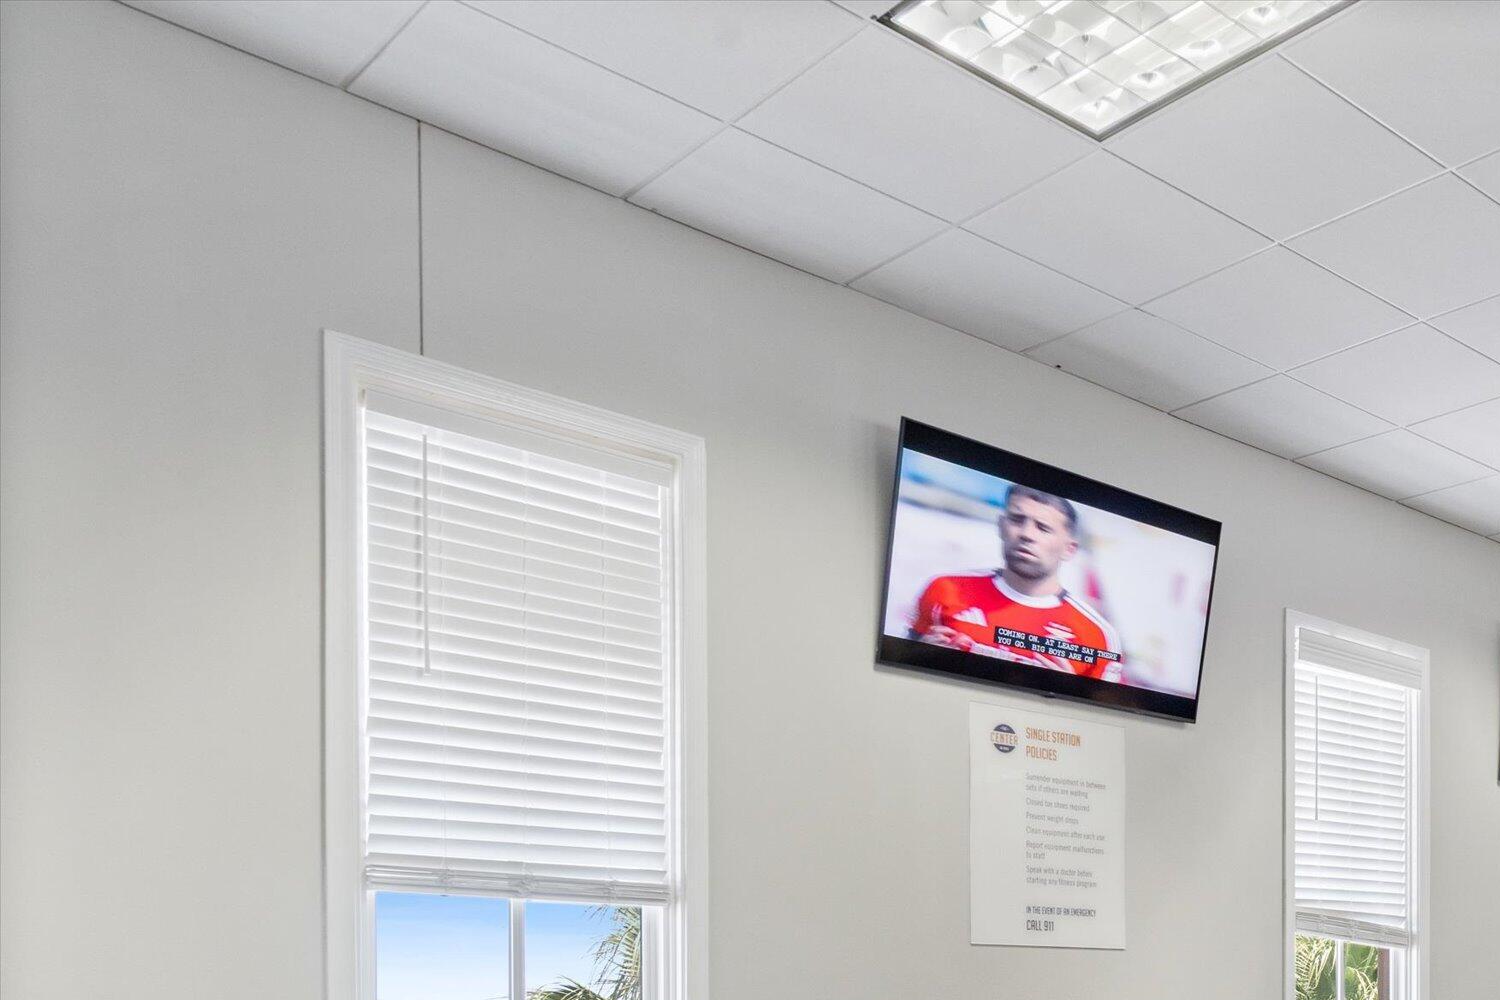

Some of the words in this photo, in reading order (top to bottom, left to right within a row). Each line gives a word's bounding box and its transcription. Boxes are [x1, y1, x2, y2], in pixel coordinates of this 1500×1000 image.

[998, 627, 1025, 639] COMING
[1028, 634, 1040, 643] ON.
[1045, 638, 1054, 647] AT
[1057, 640, 1080, 652] LEAST
[1081, 648, 1095, 656] SAY
[1097, 650, 1118, 661] THERE
[998, 636, 1012, 645] YOU
[1014, 640, 1027, 649] GO.
[1031, 644, 1046, 653] BIG
[1048, 648, 1066, 657] BOYS
[1068, 652, 1082, 661] ARE
[1084, 656, 1094, 664] ON
[991, 731, 1019, 745] CENTER
[1025, 727, 1051, 741] SINGLE
[1052, 731, 1081, 747] STATION
[1025, 745, 1058, 761] POLICIES
[1025, 905, 1032, 914] IN
[1032, 906, 1041, 915] THE
[1042, 906, 1056, 915] EVENT
[1056, 907, 1062, 915] OF
[1063, 907, 1070, 916] AN
[1070, 907, 1096, 918] EMERGENCY
[1026, 919, 1042, 931] CALL
[1043, 920, 1054, 932] 911
